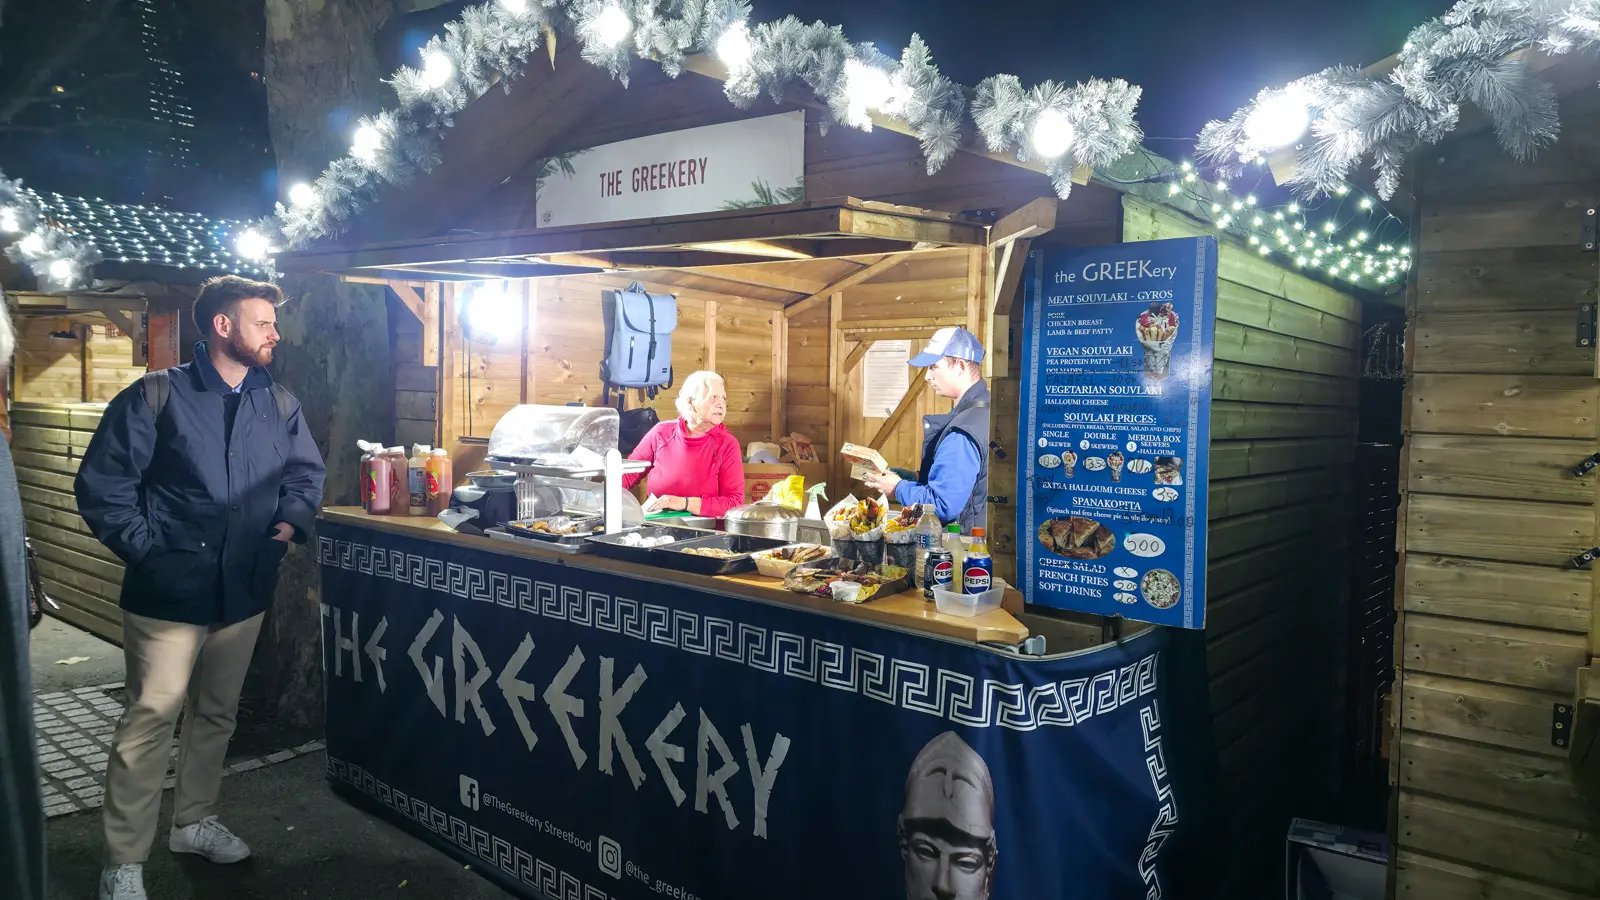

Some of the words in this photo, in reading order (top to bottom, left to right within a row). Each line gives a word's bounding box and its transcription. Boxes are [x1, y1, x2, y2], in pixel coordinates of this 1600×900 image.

[600, 170, 622, 198] THE
[632, 157, 708, 193] GREEKERY
[1055, 271, 1076, 284] the
[1082, 260, 1177, 282] GREEKery
[1048, 296, 1074, 304] MEAT
[1076, 292, 1128, 303] SOUVLAKI
[1138, 290, 1173, 300] GYROS
[1046, 347, 1079, 356] VEGAN
[1082, 346, 1133, 355] SOUVLAKI
[1045, 385, 1107, 394] VEGETARIAN
[1109, 385, 1163, 395] SOUVLAKI
[1064, 413, 1114, 422] SOUVLAKI
[1117, 414, 1157, 424] PRICES:
[1084, 432, 1116, 440] DOUBLE
[1042, 482, 1067, 491] EXTRA
[1069, 484, 1113, 494] HALLOUMI
[1115, 487, 1147, 496] CHEESE
[1046, 506, 1069, 514] (Spinach
[1073, 497, 1142, 510] SPANAKOPITA
[1073, 562, 1106, 574] SALAD
[1039, 570, 1078, 582] FRENCH
[1081, 575, 1108, 586] FRIES
[1039, 582, 1063, 592] SOFT
[1065, 585, 1102, 598] DRINKS
[320, 602, 388, 694] THE
[407, 607, 791, 840] GREEKERY
[482, 793, 543, 832] @TheGreekery
[544, 821, 592, 852] Streetfood
